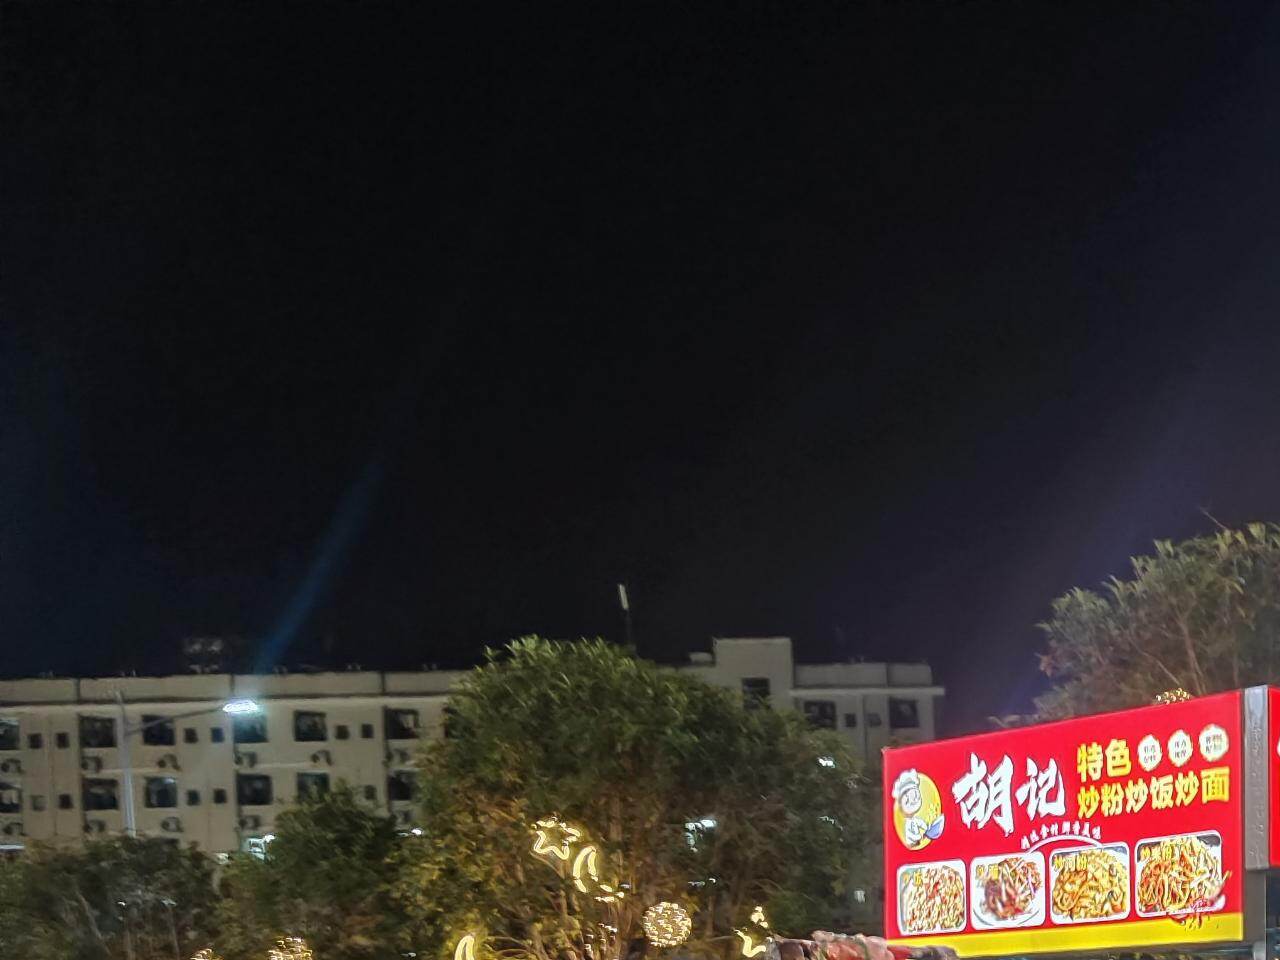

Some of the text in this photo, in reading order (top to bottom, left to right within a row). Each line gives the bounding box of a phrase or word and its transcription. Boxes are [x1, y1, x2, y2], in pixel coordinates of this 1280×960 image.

[1077, 739, 1132, 783] 特色
[952, 752, 1066, 838] 胡记
[1077, 766, 1230, 819] 炒粉炒饭炒面
